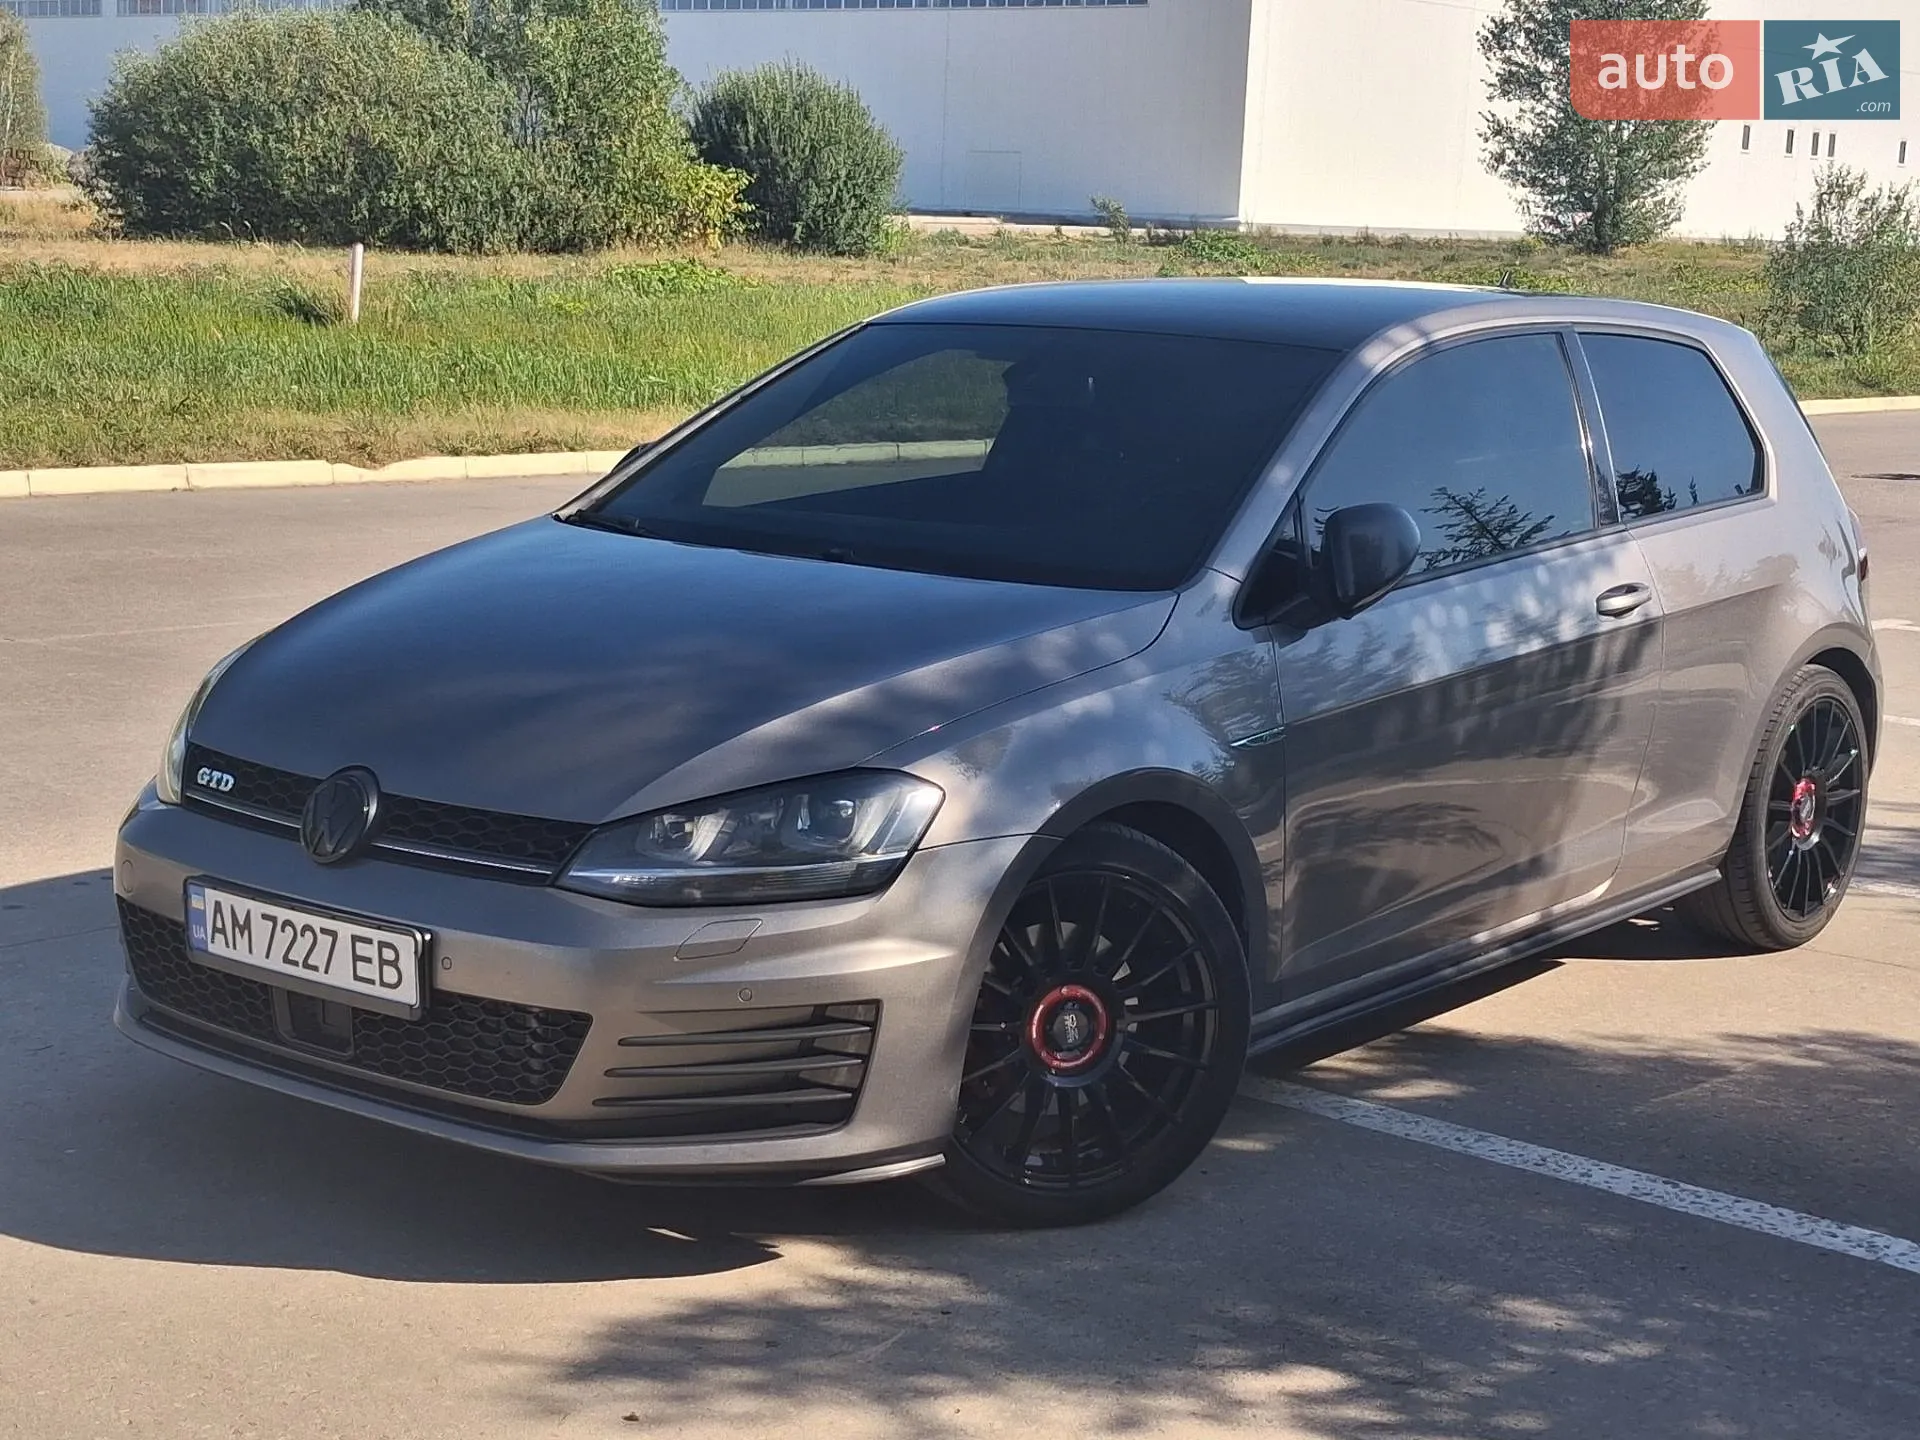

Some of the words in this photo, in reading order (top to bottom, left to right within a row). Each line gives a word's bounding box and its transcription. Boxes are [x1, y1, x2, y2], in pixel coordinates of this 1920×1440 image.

[196, 767, 235, 792] GTD
[193, 924, 206, 940] UA
[210, 900, 253, 955] AM
[261, 914, 338, 974] 7227
[350, 934, 403, 990] EB
